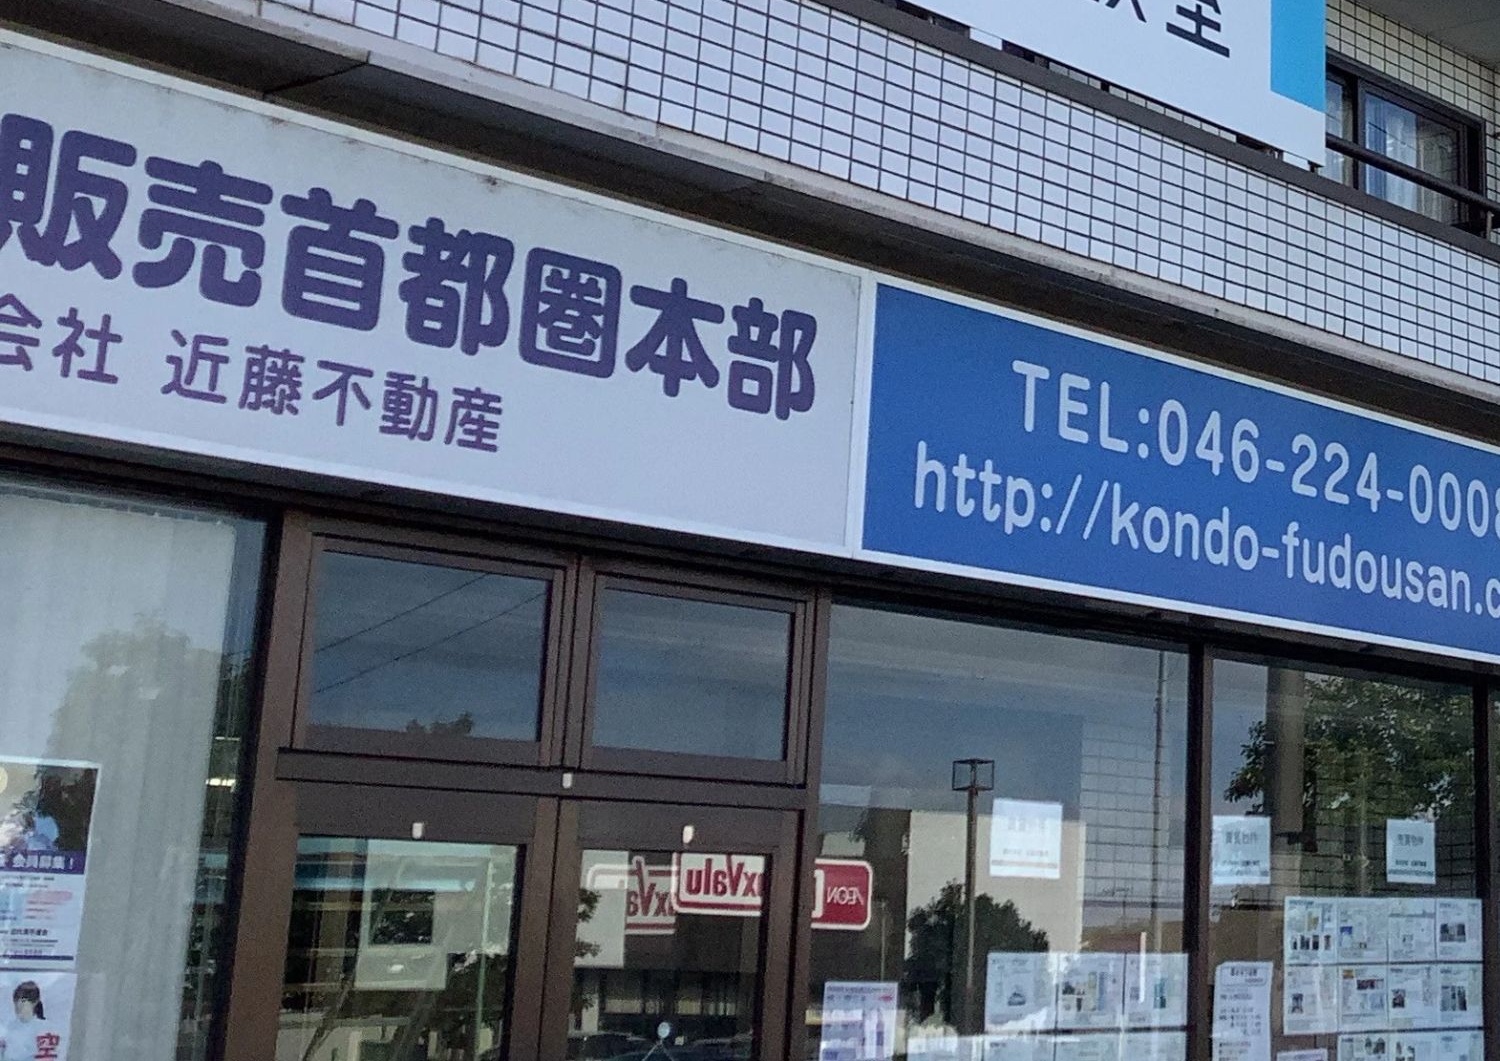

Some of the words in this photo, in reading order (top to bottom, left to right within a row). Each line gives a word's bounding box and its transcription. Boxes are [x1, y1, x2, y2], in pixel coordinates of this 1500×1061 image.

[0, 113, 817, 420] 販売首都圏本部
[161, 329, 502, 452] 近藤不動産
